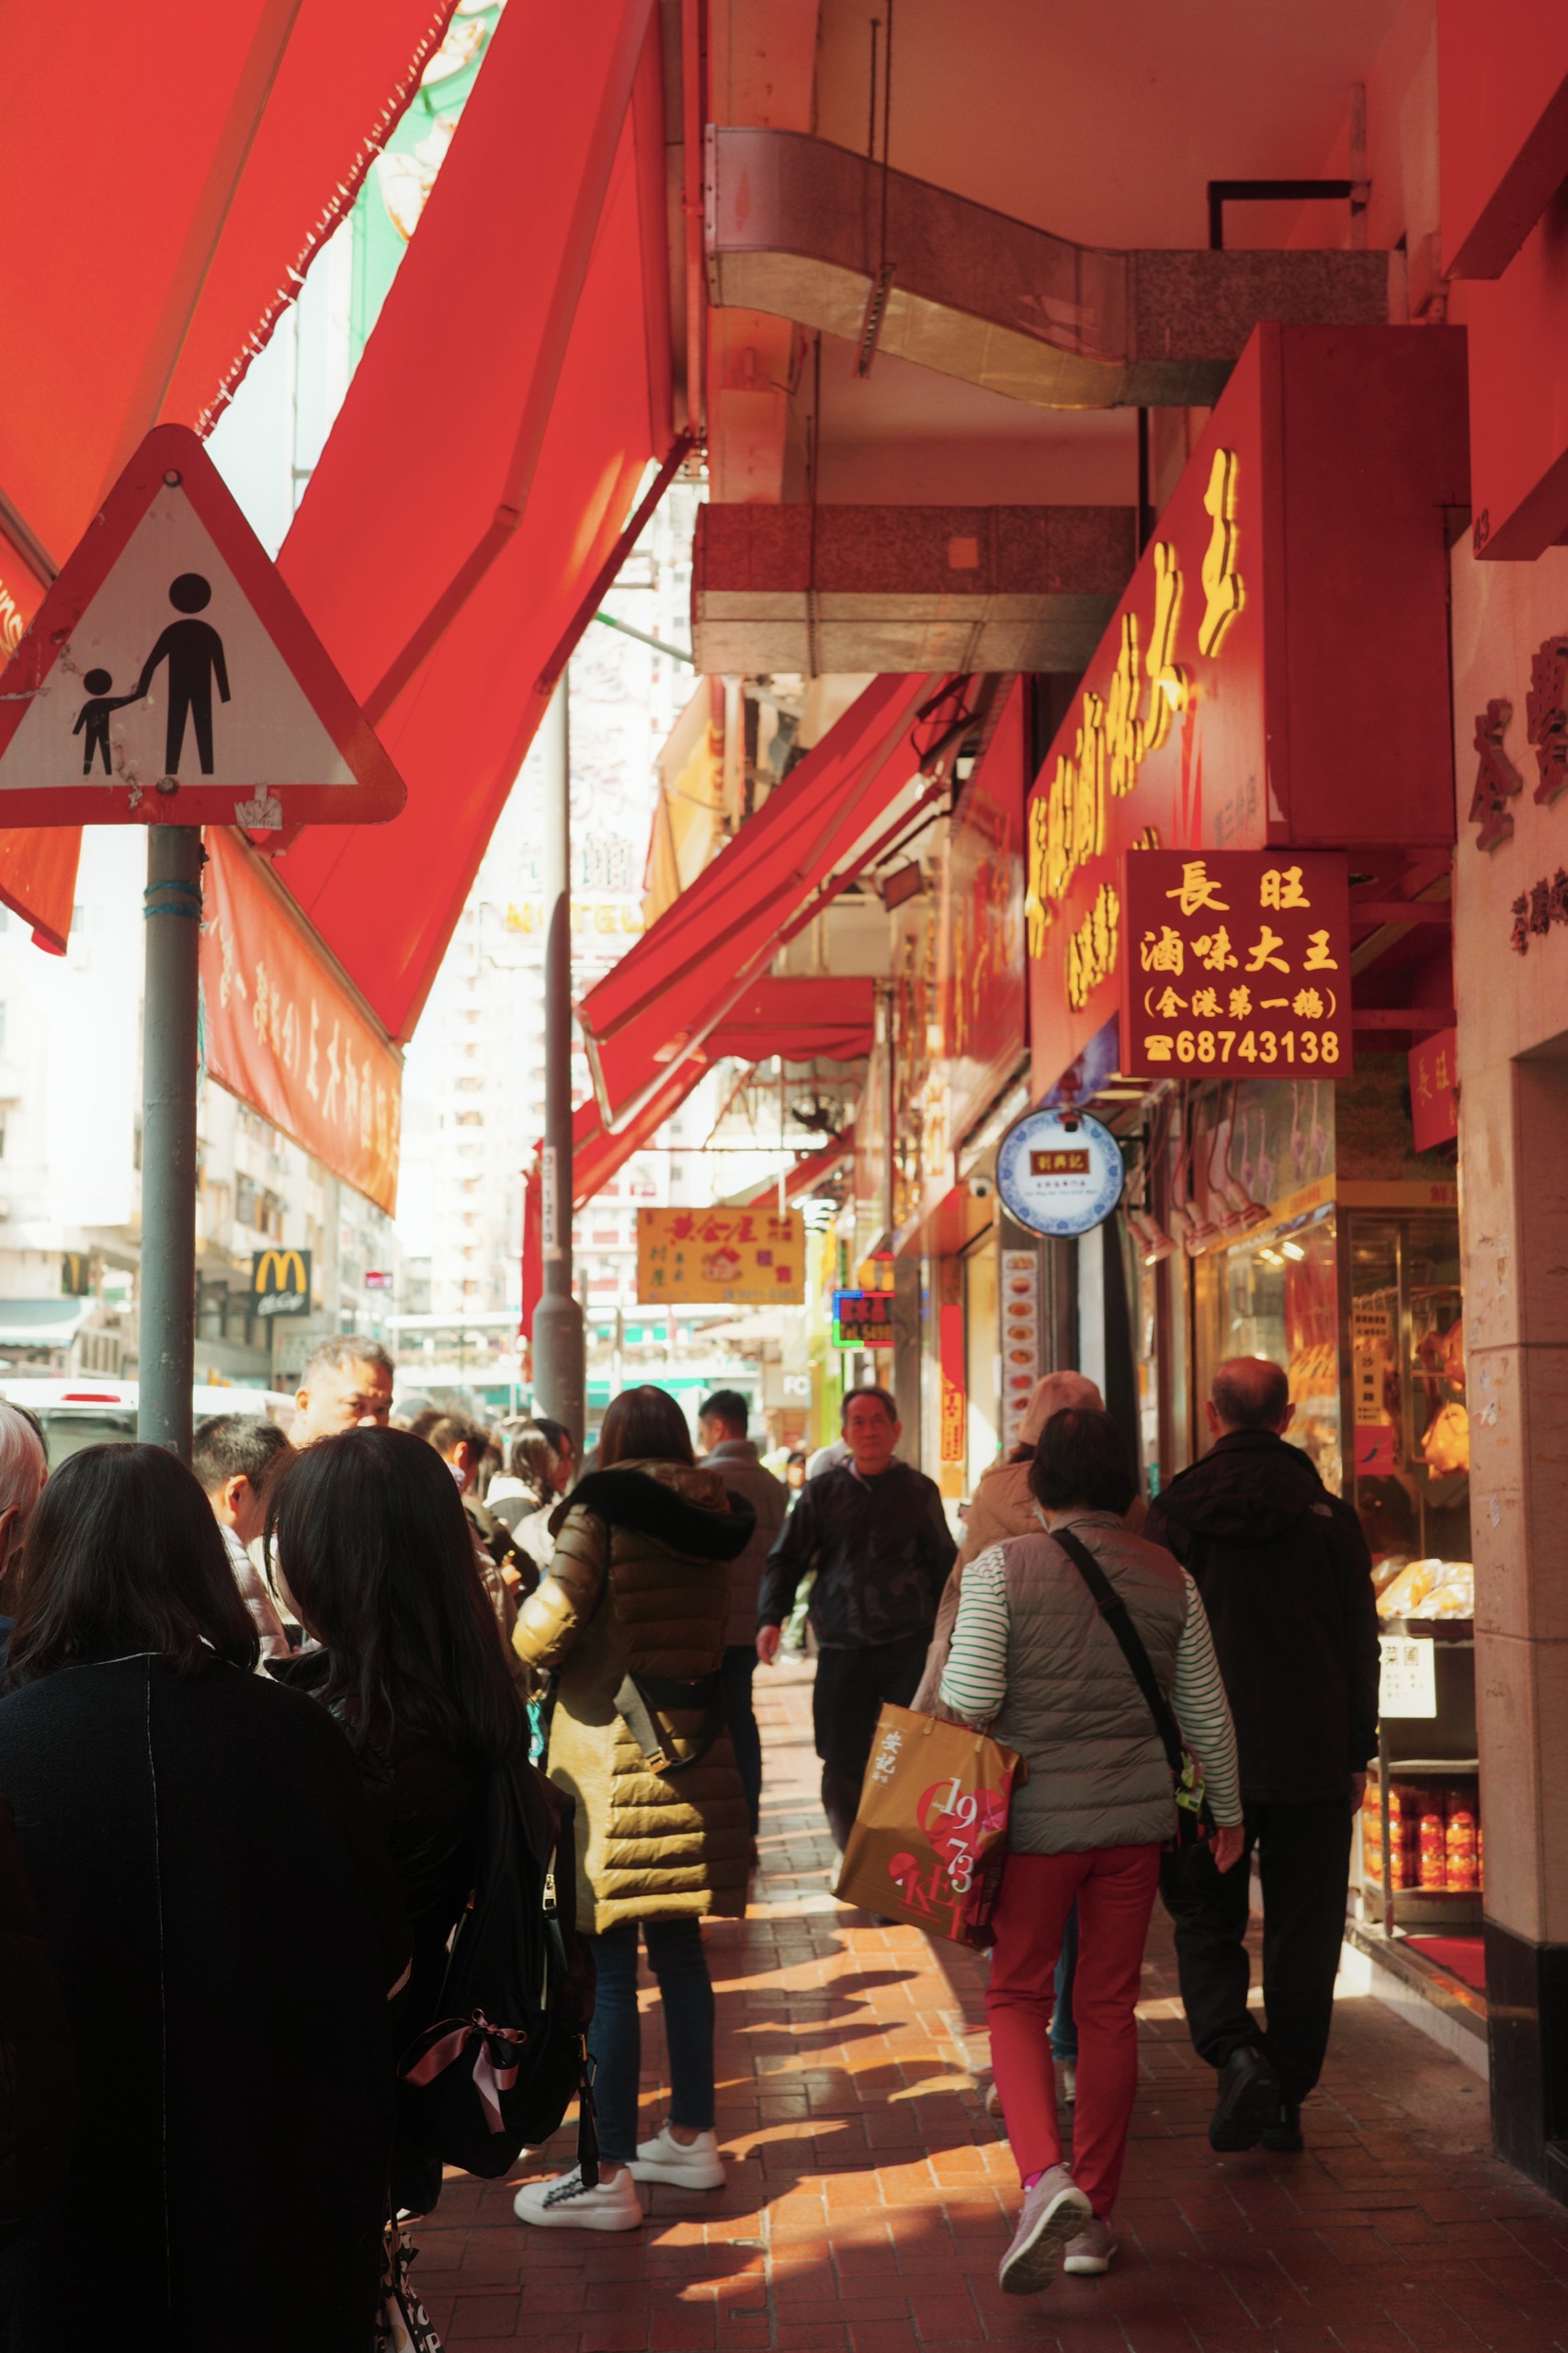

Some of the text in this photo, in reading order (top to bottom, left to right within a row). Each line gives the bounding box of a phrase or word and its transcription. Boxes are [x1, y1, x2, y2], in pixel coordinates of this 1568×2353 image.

[1165, 860, 1311, 916] 長旺
[1140, 925, 1338, 976] 滷味大王
[1144, 984, 1336, 1020] (全港第一鵝)
[1176, 1030, 1339, 1063] 68743138
[876, 1731, 903, 1775] 安記
